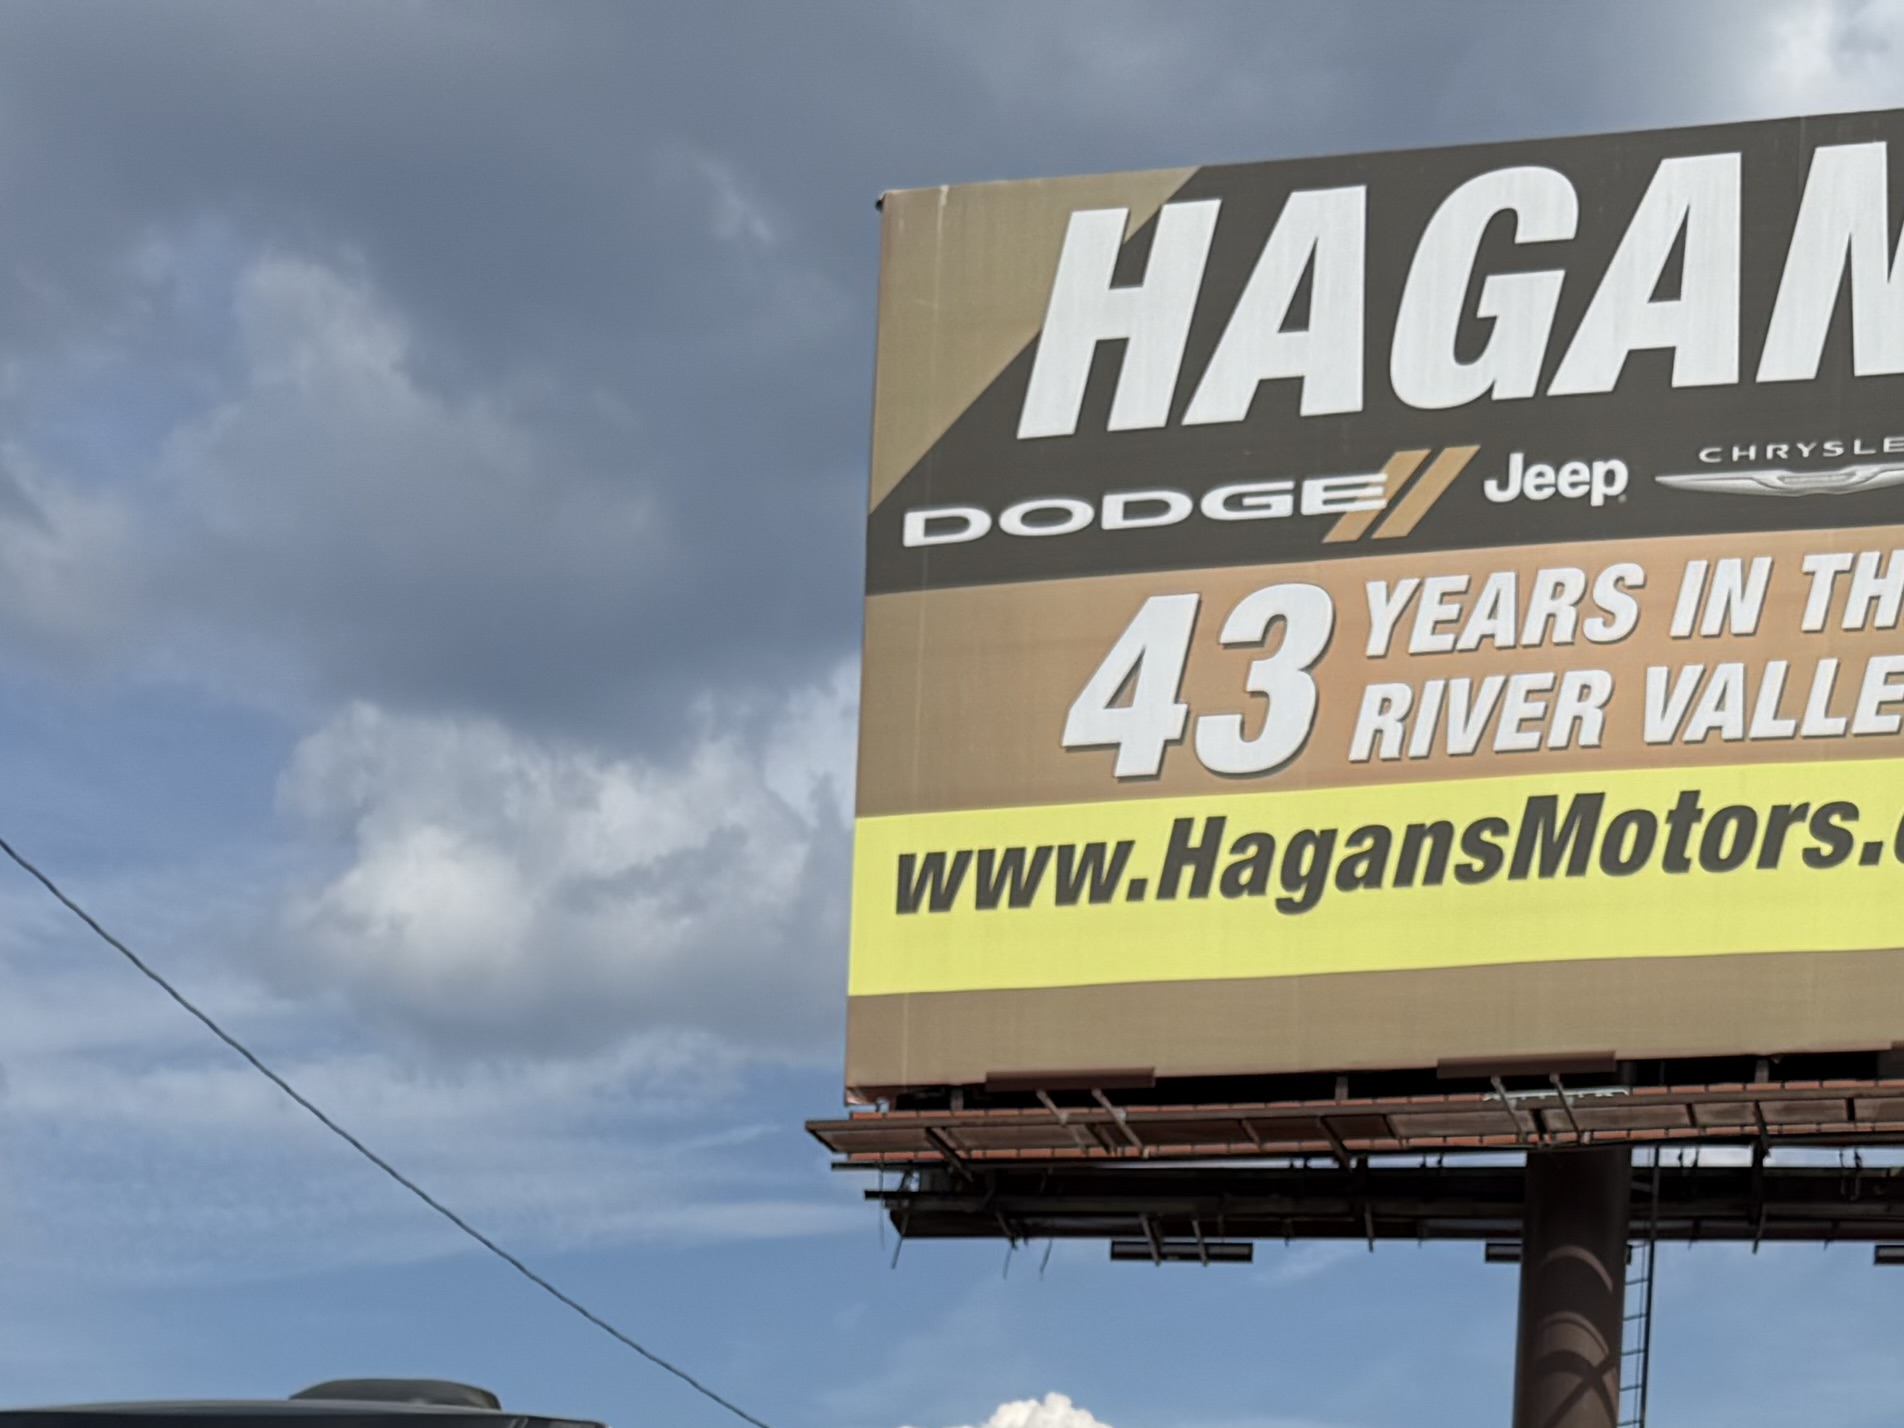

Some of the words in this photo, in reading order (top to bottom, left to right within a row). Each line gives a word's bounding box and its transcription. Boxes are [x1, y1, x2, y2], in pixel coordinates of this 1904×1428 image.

[902, 471, 1390, 548] DODGE
[1483, 452, 1630, 507] Jeep
[1363, 560, 1641, 660] YEARS
[1674, 553, 1773, 640] IN
[1058, 578, 1336, 779] 43
[1347, 668, 1616, 765] RIVER
